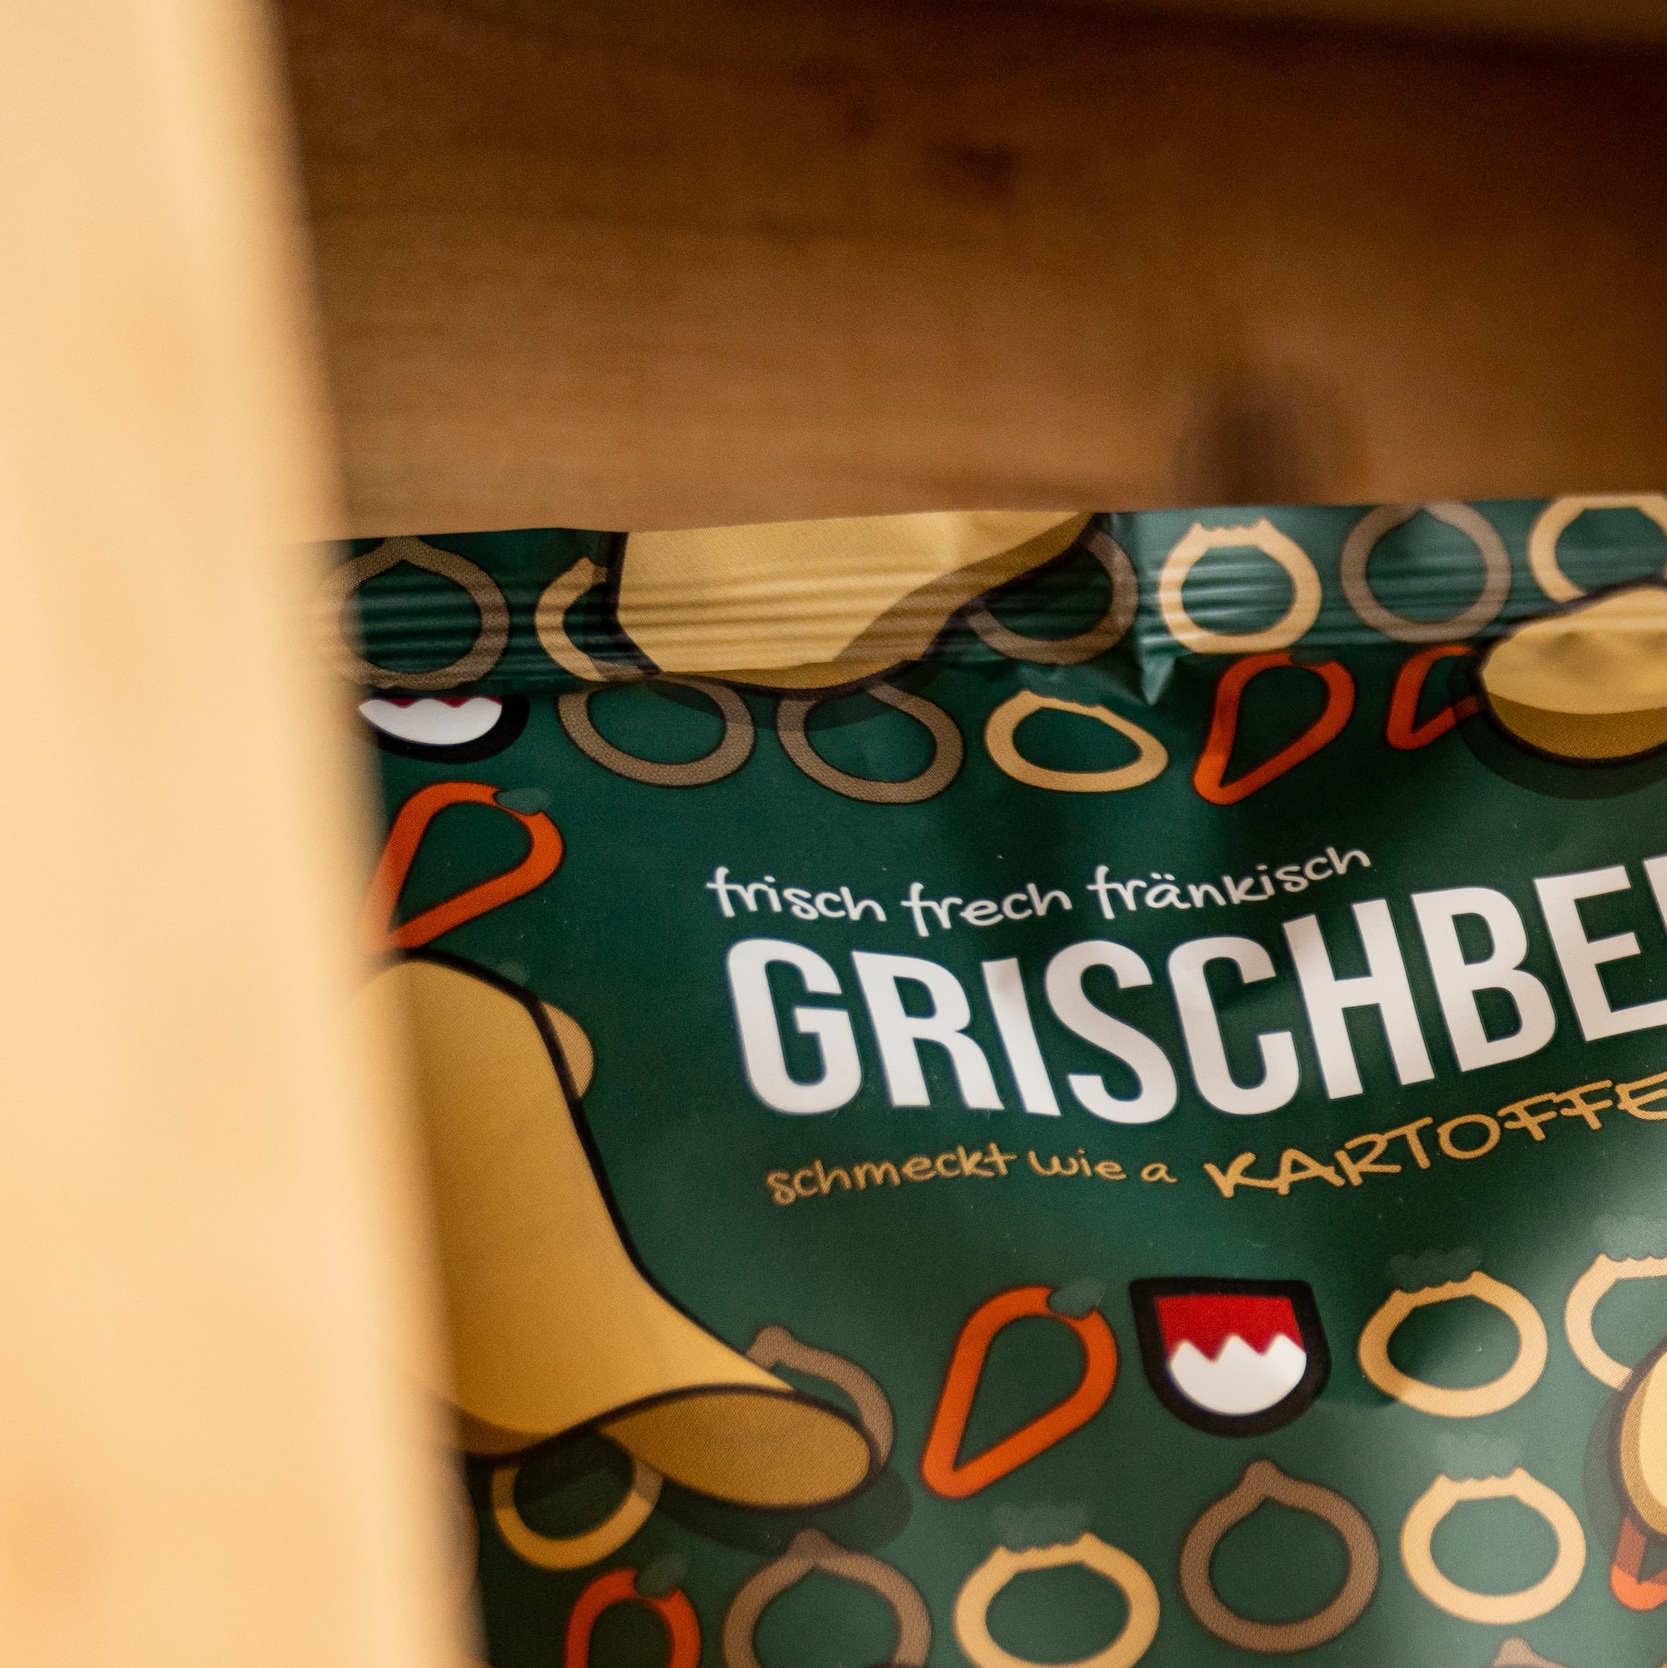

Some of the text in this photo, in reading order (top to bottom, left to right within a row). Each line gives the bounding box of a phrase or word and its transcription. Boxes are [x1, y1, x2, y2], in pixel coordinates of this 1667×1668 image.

[706, 846, 1371, 937] frisch frech fränkisch
[765, 1142, 1019, 1208] schmeckt
[1029, 1145, 1131, 1184] wie
[1138, 1156, 1179, 1186] a
